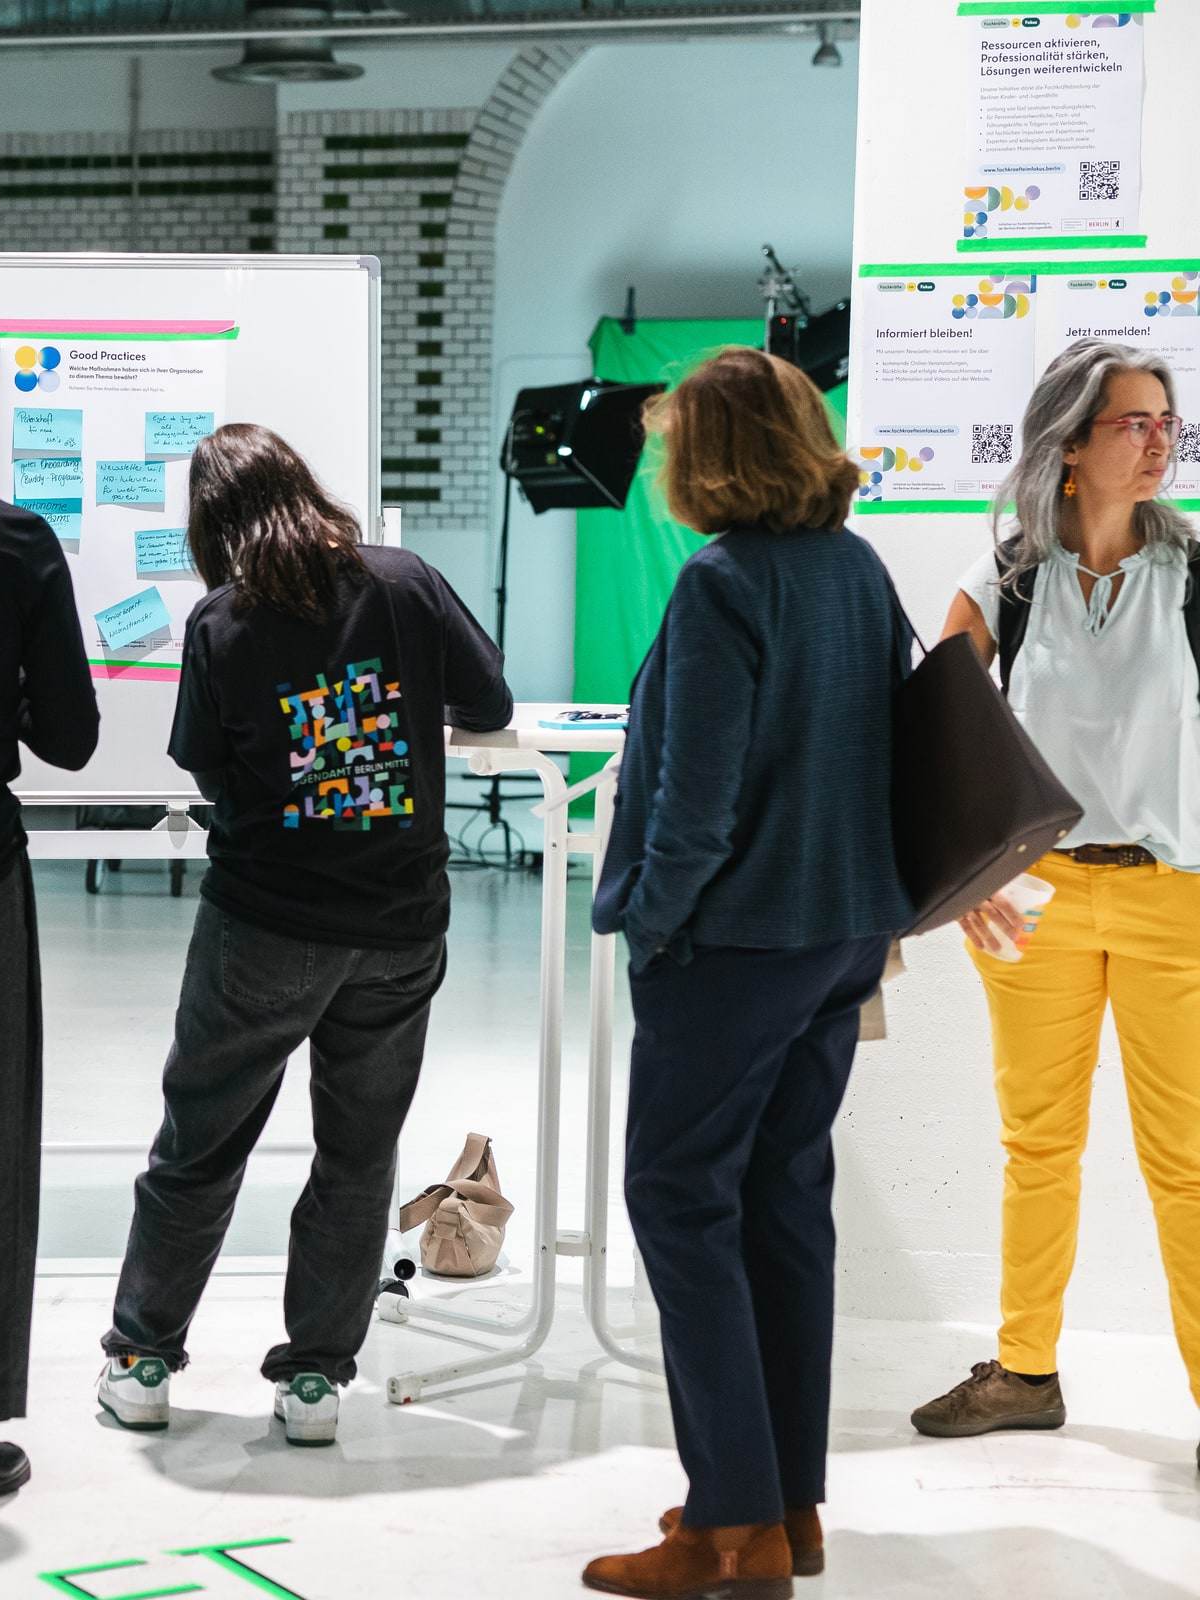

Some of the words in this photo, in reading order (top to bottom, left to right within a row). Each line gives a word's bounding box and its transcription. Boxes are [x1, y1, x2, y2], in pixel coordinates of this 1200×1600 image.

[981, 40, 1041, 50] Ressourcen
[1044, 38, 1100, 48] aktivieren,
[981, 52, 1063, 63] Professionalität
[1066, 50, 1109, 61] stärken,
[980, 66, 1031, 77] Lösungen
[1034, 62, 1123, 74] weiterentwickeln
[876, 328, 927, 338] Informiert
[930, 328, 973, 338] bleiben!
[1065, 327, 1091, 337] Jetzt
[1094, 326, 1150, 336] anmelden!
[70, 350, 98, 360] Good
[100, 350, 146, 361] Practices
[354, 762, 384, 774] BERLIN
[384, 758, 410, 769] MITTE
